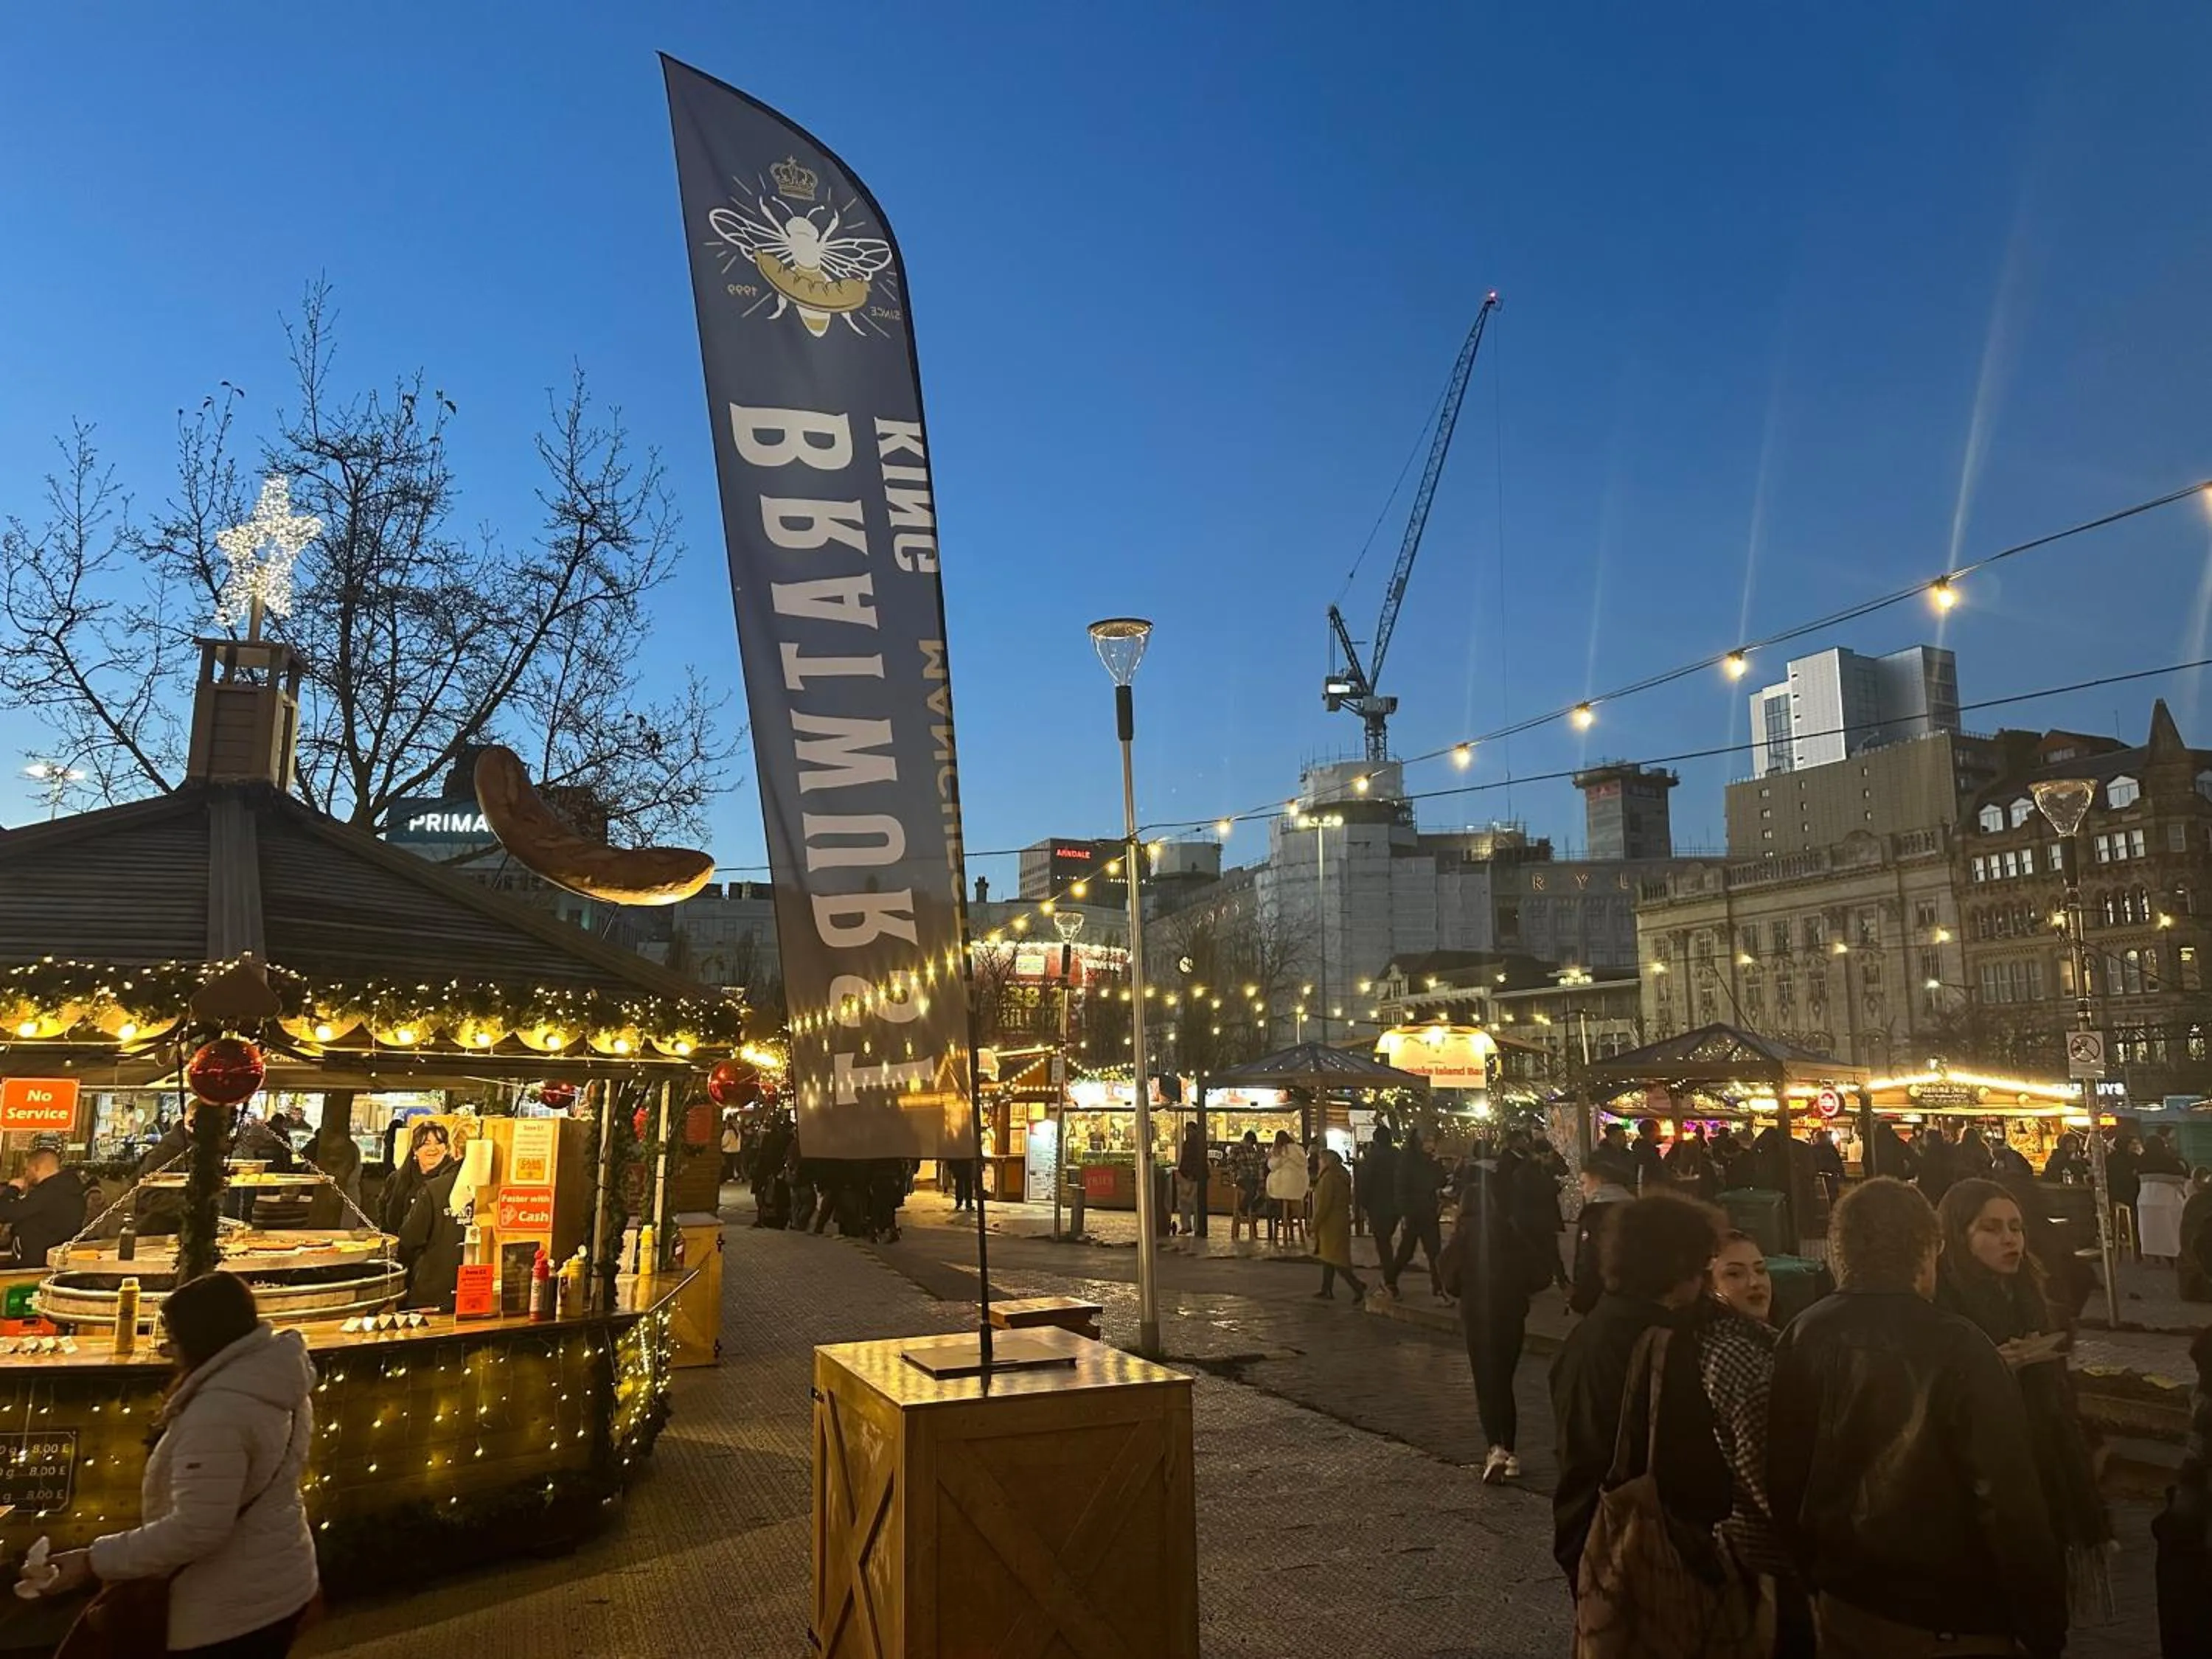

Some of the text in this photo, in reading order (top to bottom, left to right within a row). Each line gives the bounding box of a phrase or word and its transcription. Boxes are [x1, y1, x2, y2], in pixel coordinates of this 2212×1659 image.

[1434, 1066, 1464, 1076] Island
[1467, 1067, 1484, 1075] Bar
[27, 1090, 52, 1102] No
[6, 1107, 69, 1119] Service
[518, 1211, 549, 1222] Cash
